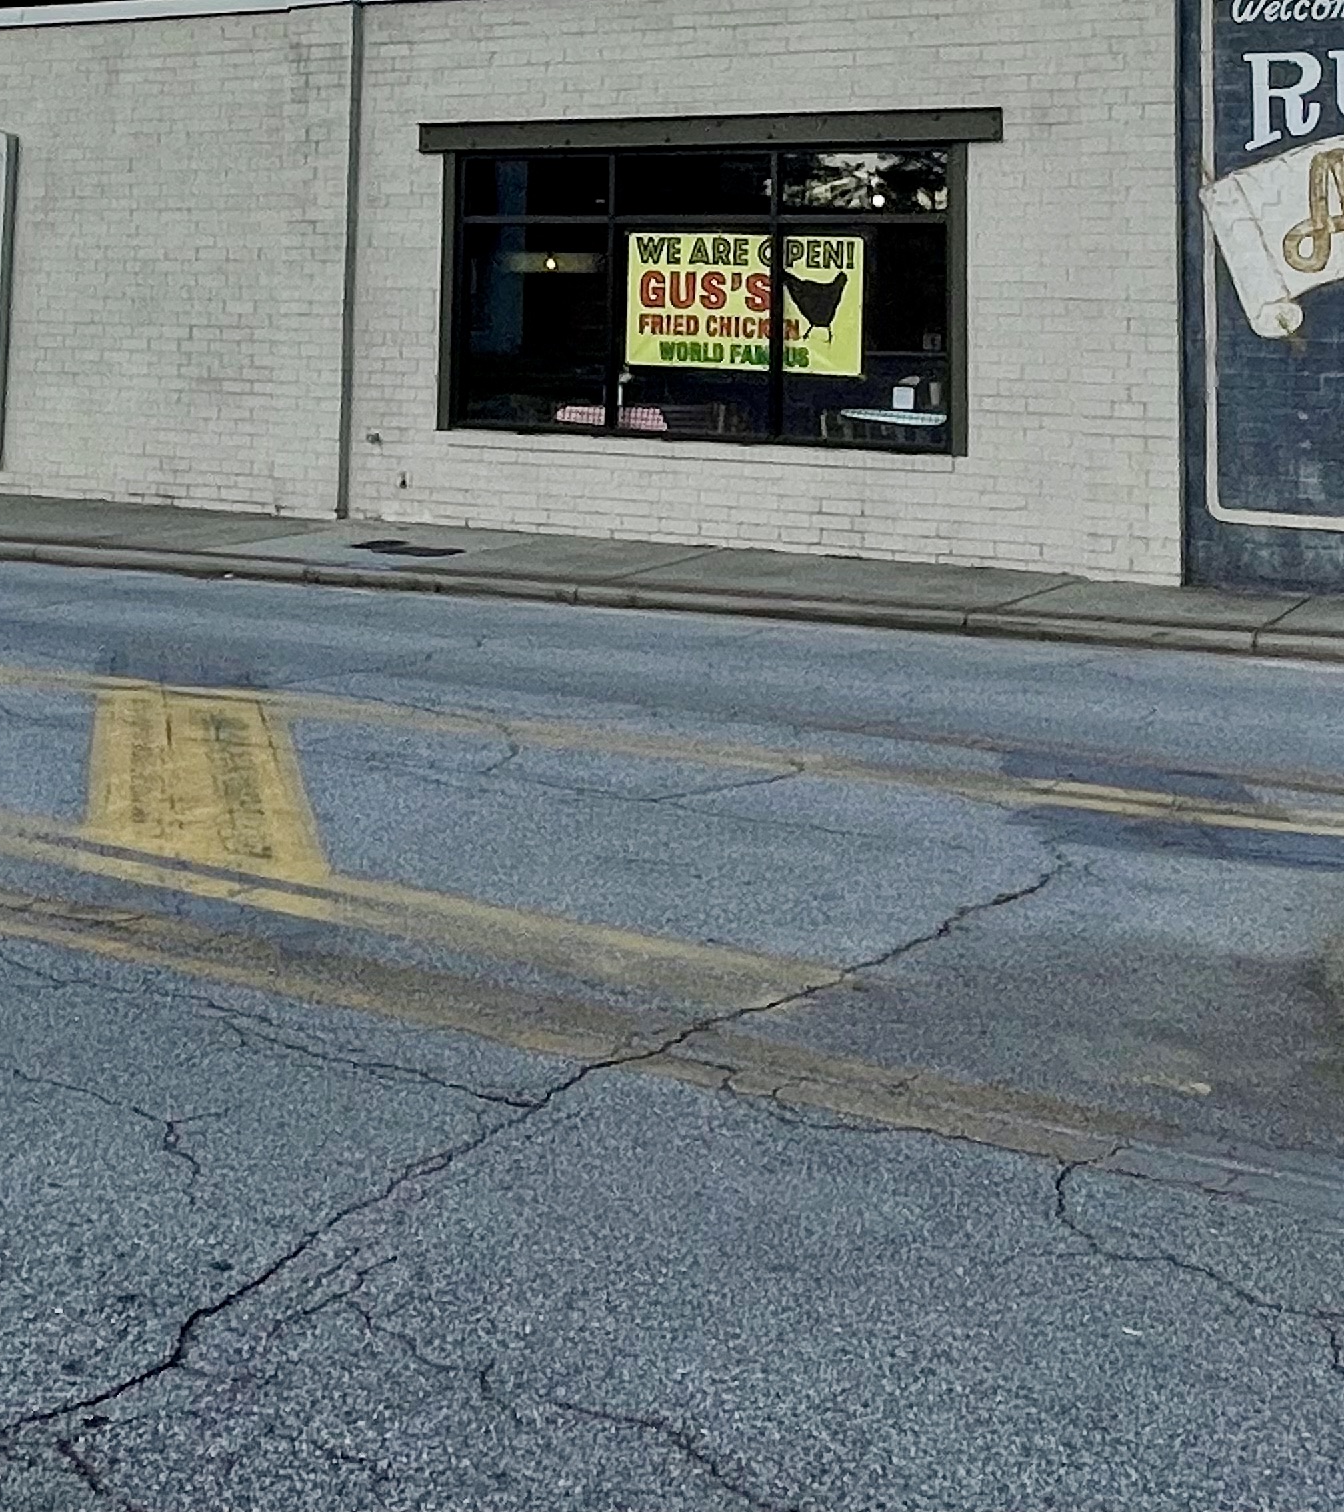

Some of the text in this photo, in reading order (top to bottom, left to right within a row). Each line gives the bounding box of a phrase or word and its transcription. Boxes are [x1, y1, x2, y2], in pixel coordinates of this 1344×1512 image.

[636, 237, 681, 265] WE
[689, 236, 749, 266] ARE
[640, 269, 772, 313] GUS'S
[638, 313, 800, 341] FRIED CHICKN
[659, 340, 810, 368] WORLD FAMUS
